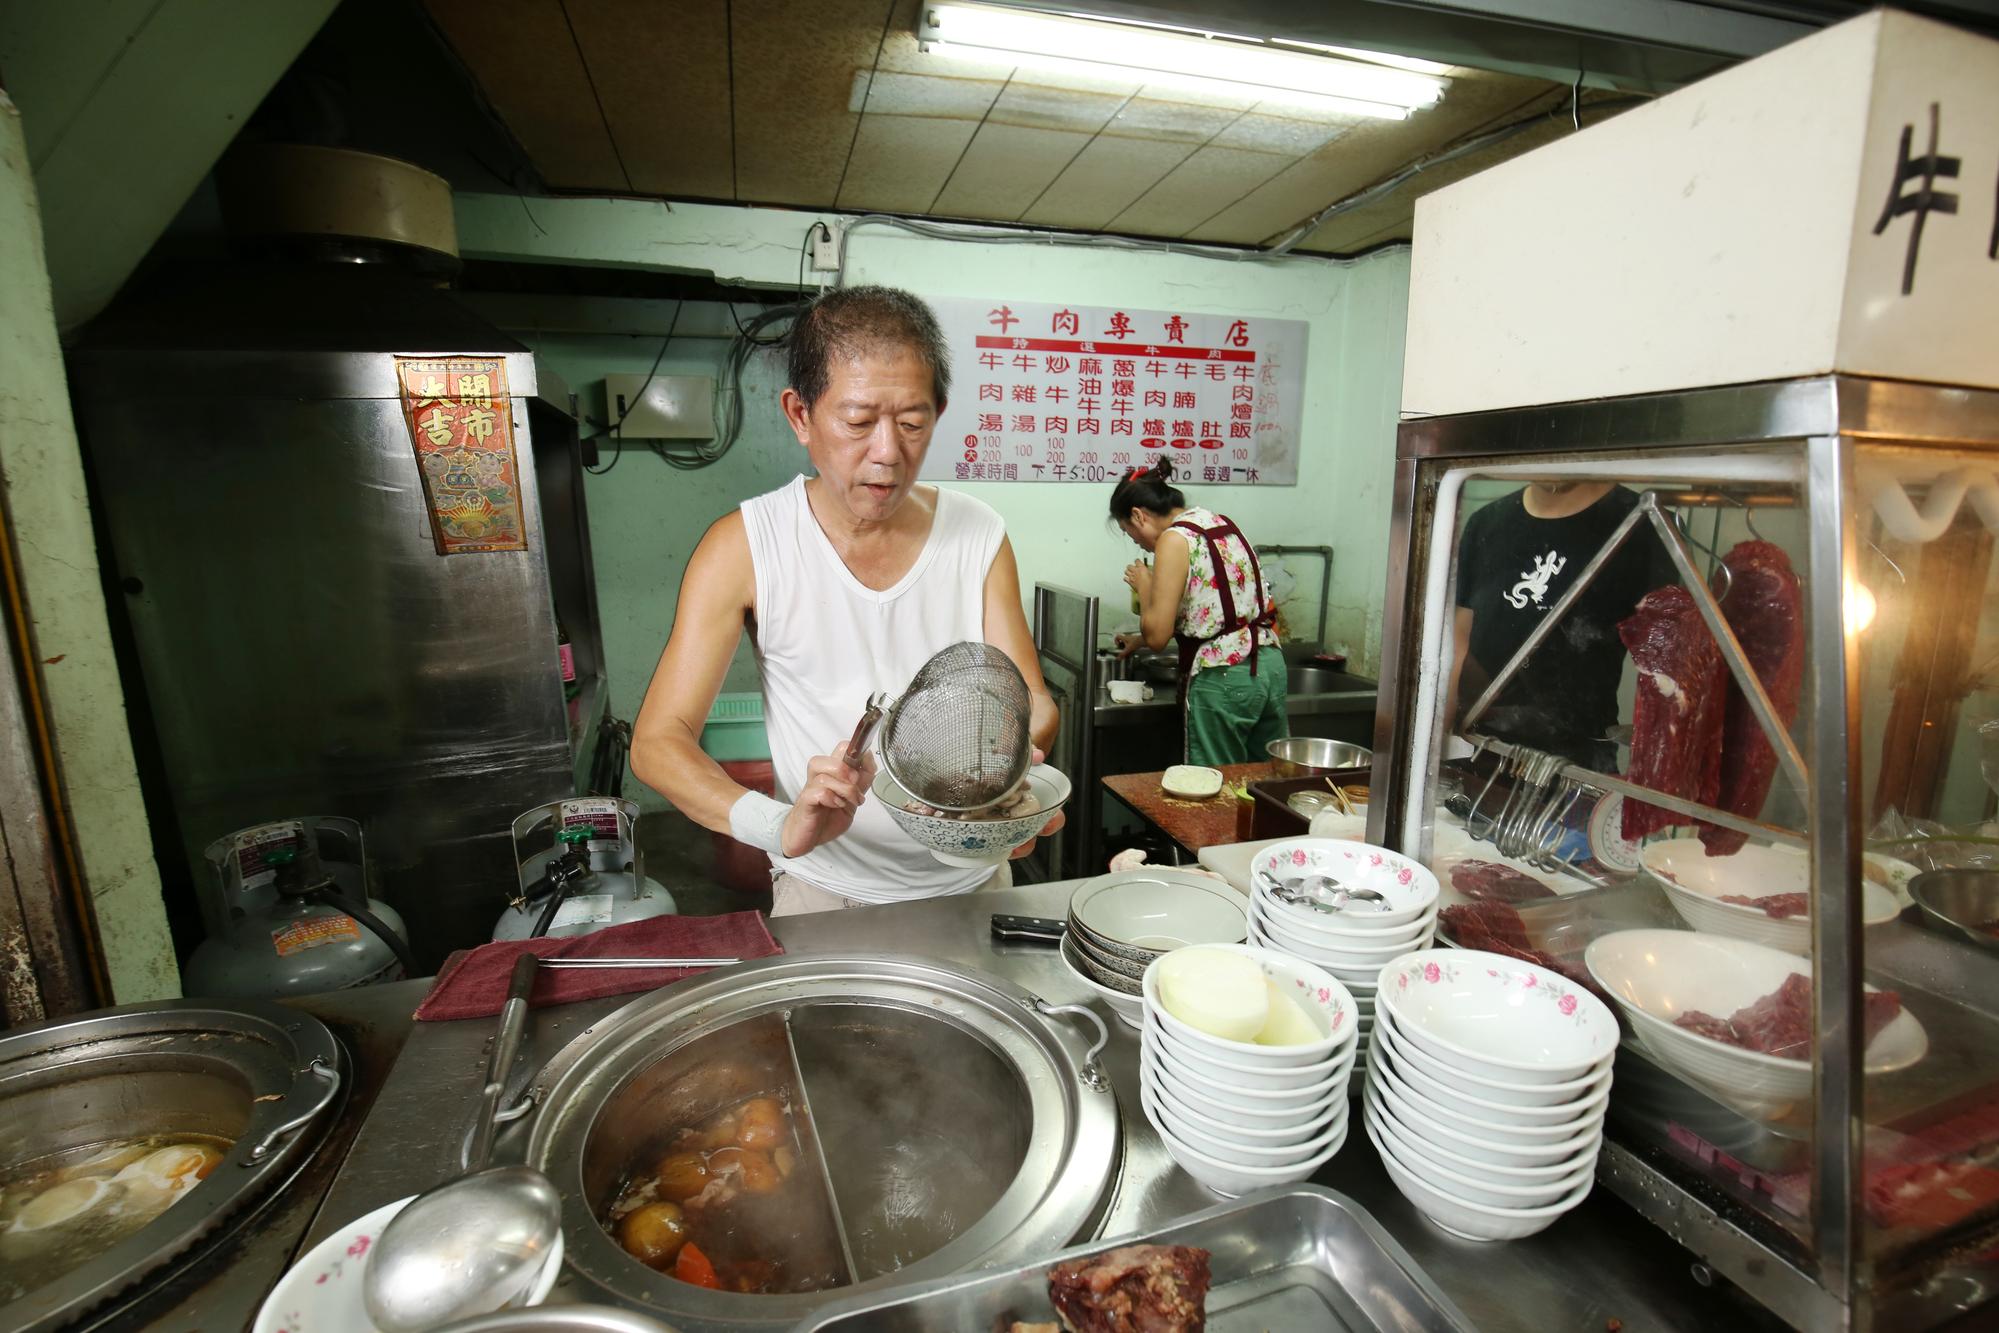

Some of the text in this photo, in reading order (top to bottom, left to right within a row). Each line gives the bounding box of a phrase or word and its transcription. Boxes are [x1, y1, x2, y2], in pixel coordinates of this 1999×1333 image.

[1872, 101, 1999, 296] 牛
[986, 304, 1250, 347] 牛肉專賣店
[417, 375, 457, 446] 大吉
[458, 374, 497, 446] 開市
[979, 352, 1004, 432] 牛肉湯
[1012, 354, 1037, 433] 牛雜湯
[1045, 355, 1071, 434] 炒牛肉
[1077, 358, 1102, 435] 麻油牛肉
[1143, 361, 1168, 437] 牛肉爐
[1171, 362, 1197, 438] 牛腩爐
[1201, 364, 1226, 438] 毛肚
[1230, 365, 1255, 439] 牛肉燴飯
[966, 436, 1001, 448] 小 100
[966, 450, 1002, 463] 大 200
[1015, 445, 1032, 457] 100
[1046, 451, 1065, 464] 200
[1047, 437, 1065, 450] 100
[1079, 452, 1098, 464] 200
[1112, 453, 1130, 464] 200
[1174, 453, 1192, 465] 250
[1232, 448, 1248, 460] 100
[956, 462, 1018, 480] 營業時間
